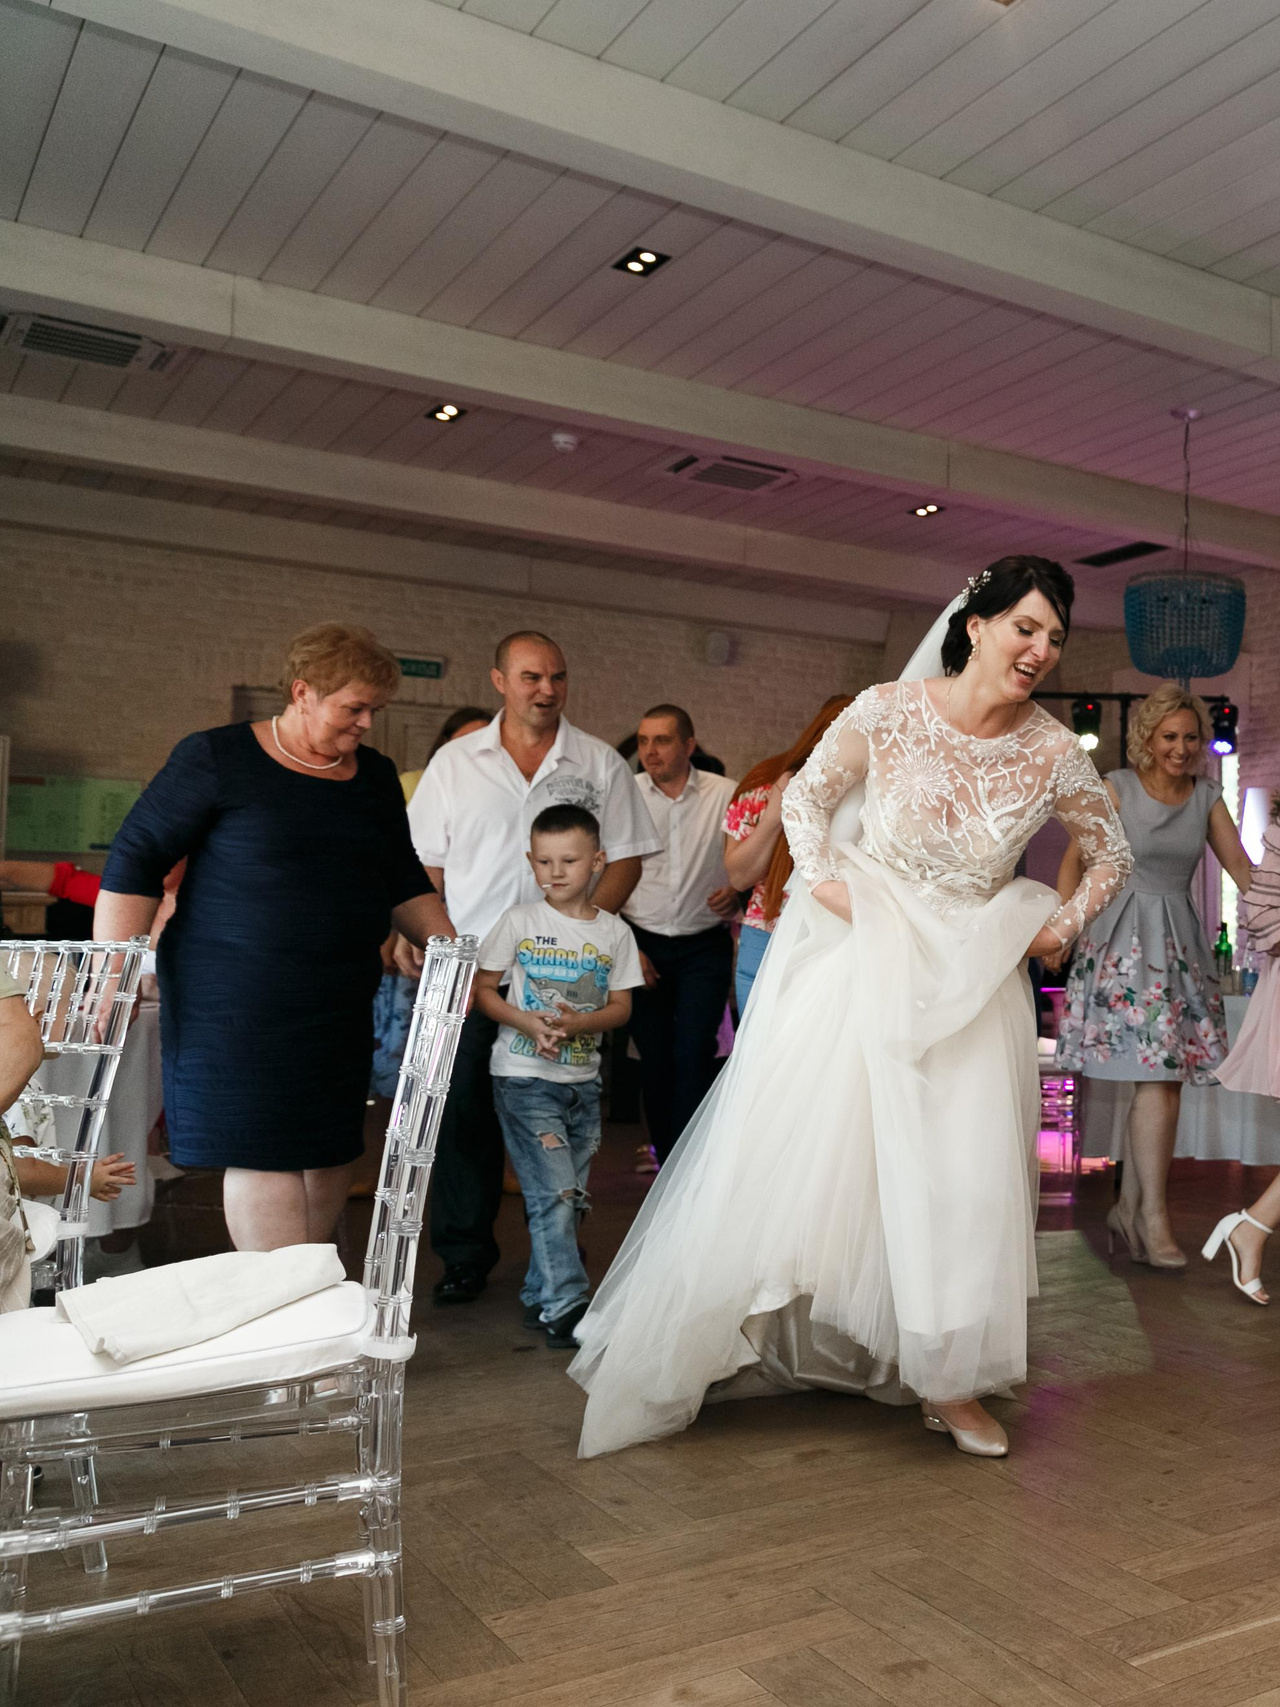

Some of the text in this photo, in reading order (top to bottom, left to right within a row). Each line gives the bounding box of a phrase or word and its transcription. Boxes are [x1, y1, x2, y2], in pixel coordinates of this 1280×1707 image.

[518, 938, 578, 969] SHARK
[535, 936, 557, 946] THE
[510, 1034, 572, 1065] OCN
